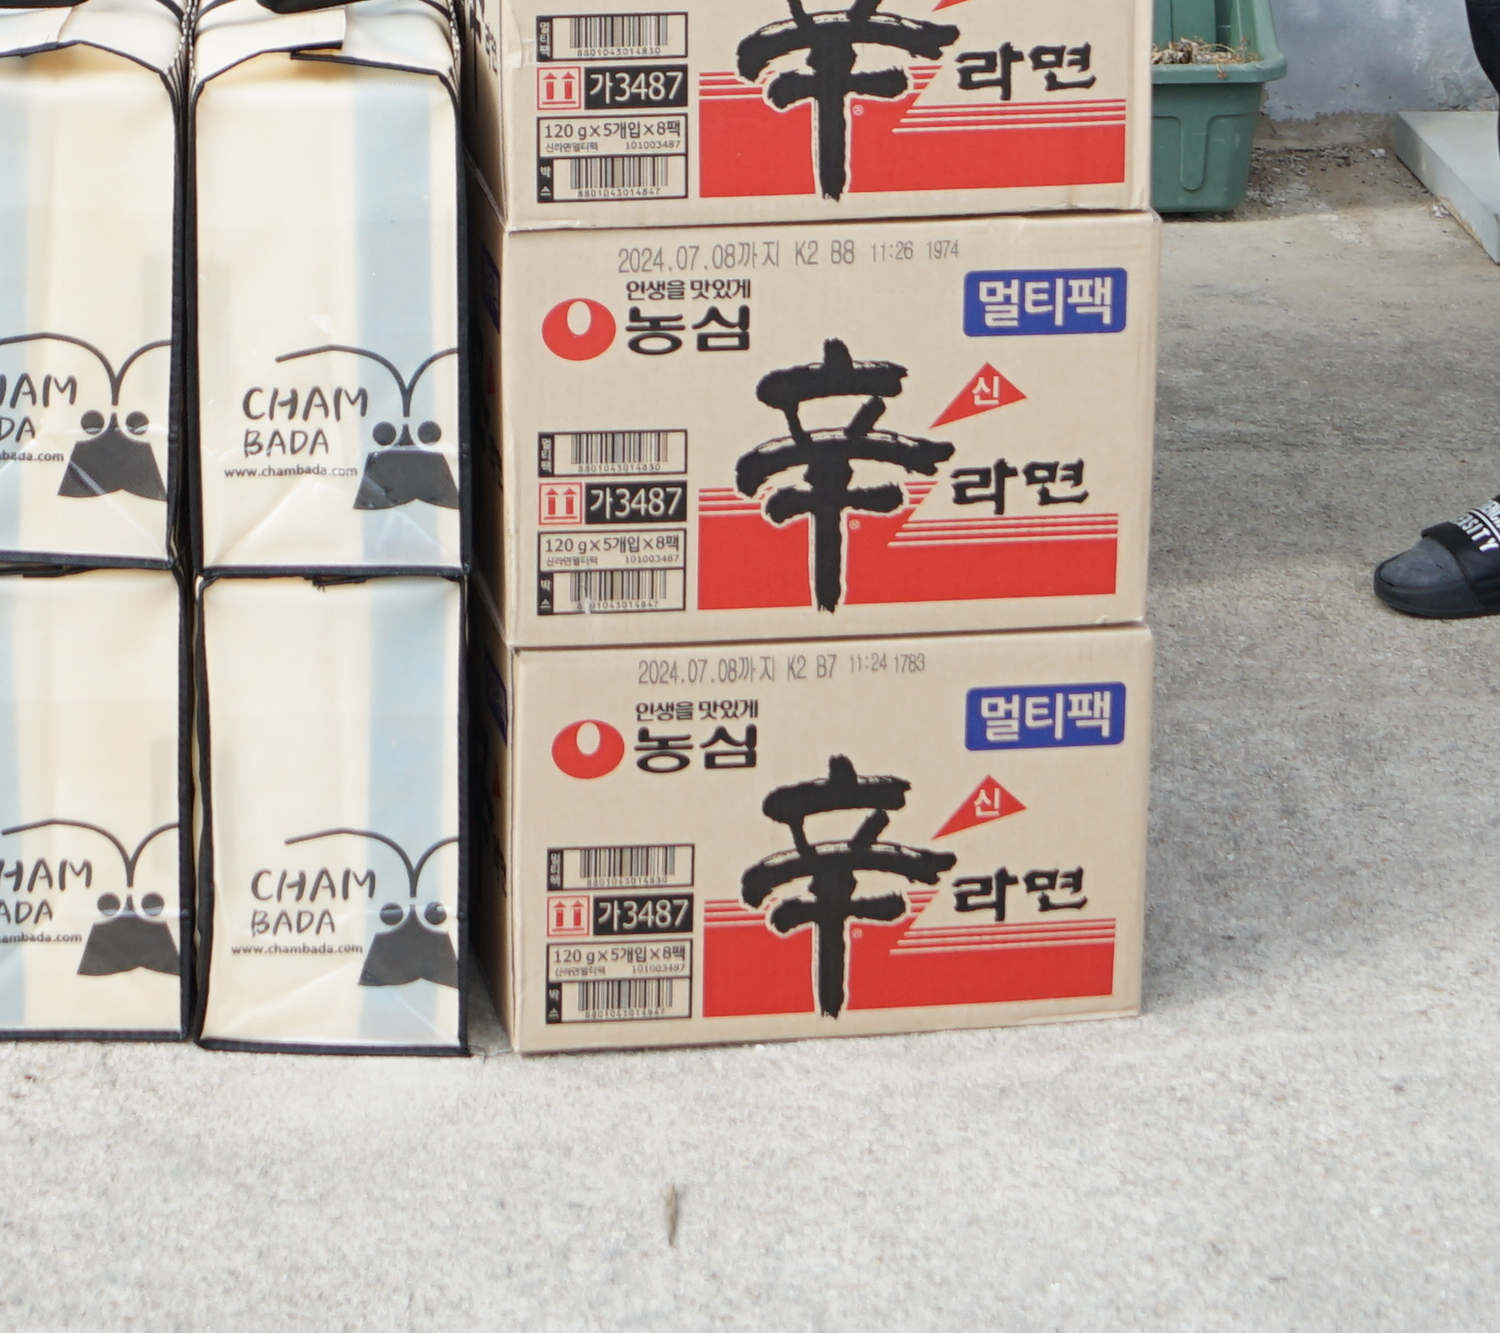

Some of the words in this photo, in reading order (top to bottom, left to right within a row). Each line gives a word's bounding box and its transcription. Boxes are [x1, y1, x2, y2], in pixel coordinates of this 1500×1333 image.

[589, 71, 683, 104] 가3487
[955, 41, 1098, 101] 라면
[625, 140, 681, 150] 101003487
[617, 241, 780, 275] 2024.07.08까지
[794, 240, 819, 268] K2
[870, 239, 914, 262] 11:26
[925, 239, 960, 260] 1974
[625, 279, 686, 302] 인생을
[689, 278, 752, 300] 맛있게
[978, 276, 1113, 327] 멀티팩
[625, 304, 752, 356] 농심
[242, 386, 369, 422] CHAM
[970, 374, 1001, 406] 신
[243, 430, 330, 458] BADA
[223, 464, 358, 479] www.chambada.com
[734, 337, 956, 613] 辛
[950, 457, 1090, 515] 라면
[590, 487, 683, 520] 가3487
[638, 654, 776, 687] 2024.07.08까지
[786, 654, 807, 681] K2
[815, 653, 837, 679] B7
[849, 653, 888, 675] 11:24
[893, 652, 926, 674] 1783
[635, 699, 694, 721] 인생을
[698, 698, 759, 720] 맛있게
[980, 691, 1112, 742] 멀티팩
[634, 724, 758, 774] 농심
[972, 787, 1001, 818] 신
[250, 867, 377, 903] CHAM
[740, 754, 957, 1020] 辛
[952, 866, 1088, 923] 라면
[251, 908, 337, 937] BADA
[598, 899, 689, 932] 가3487
[231, 942, 364, 957] www.chambada.com
